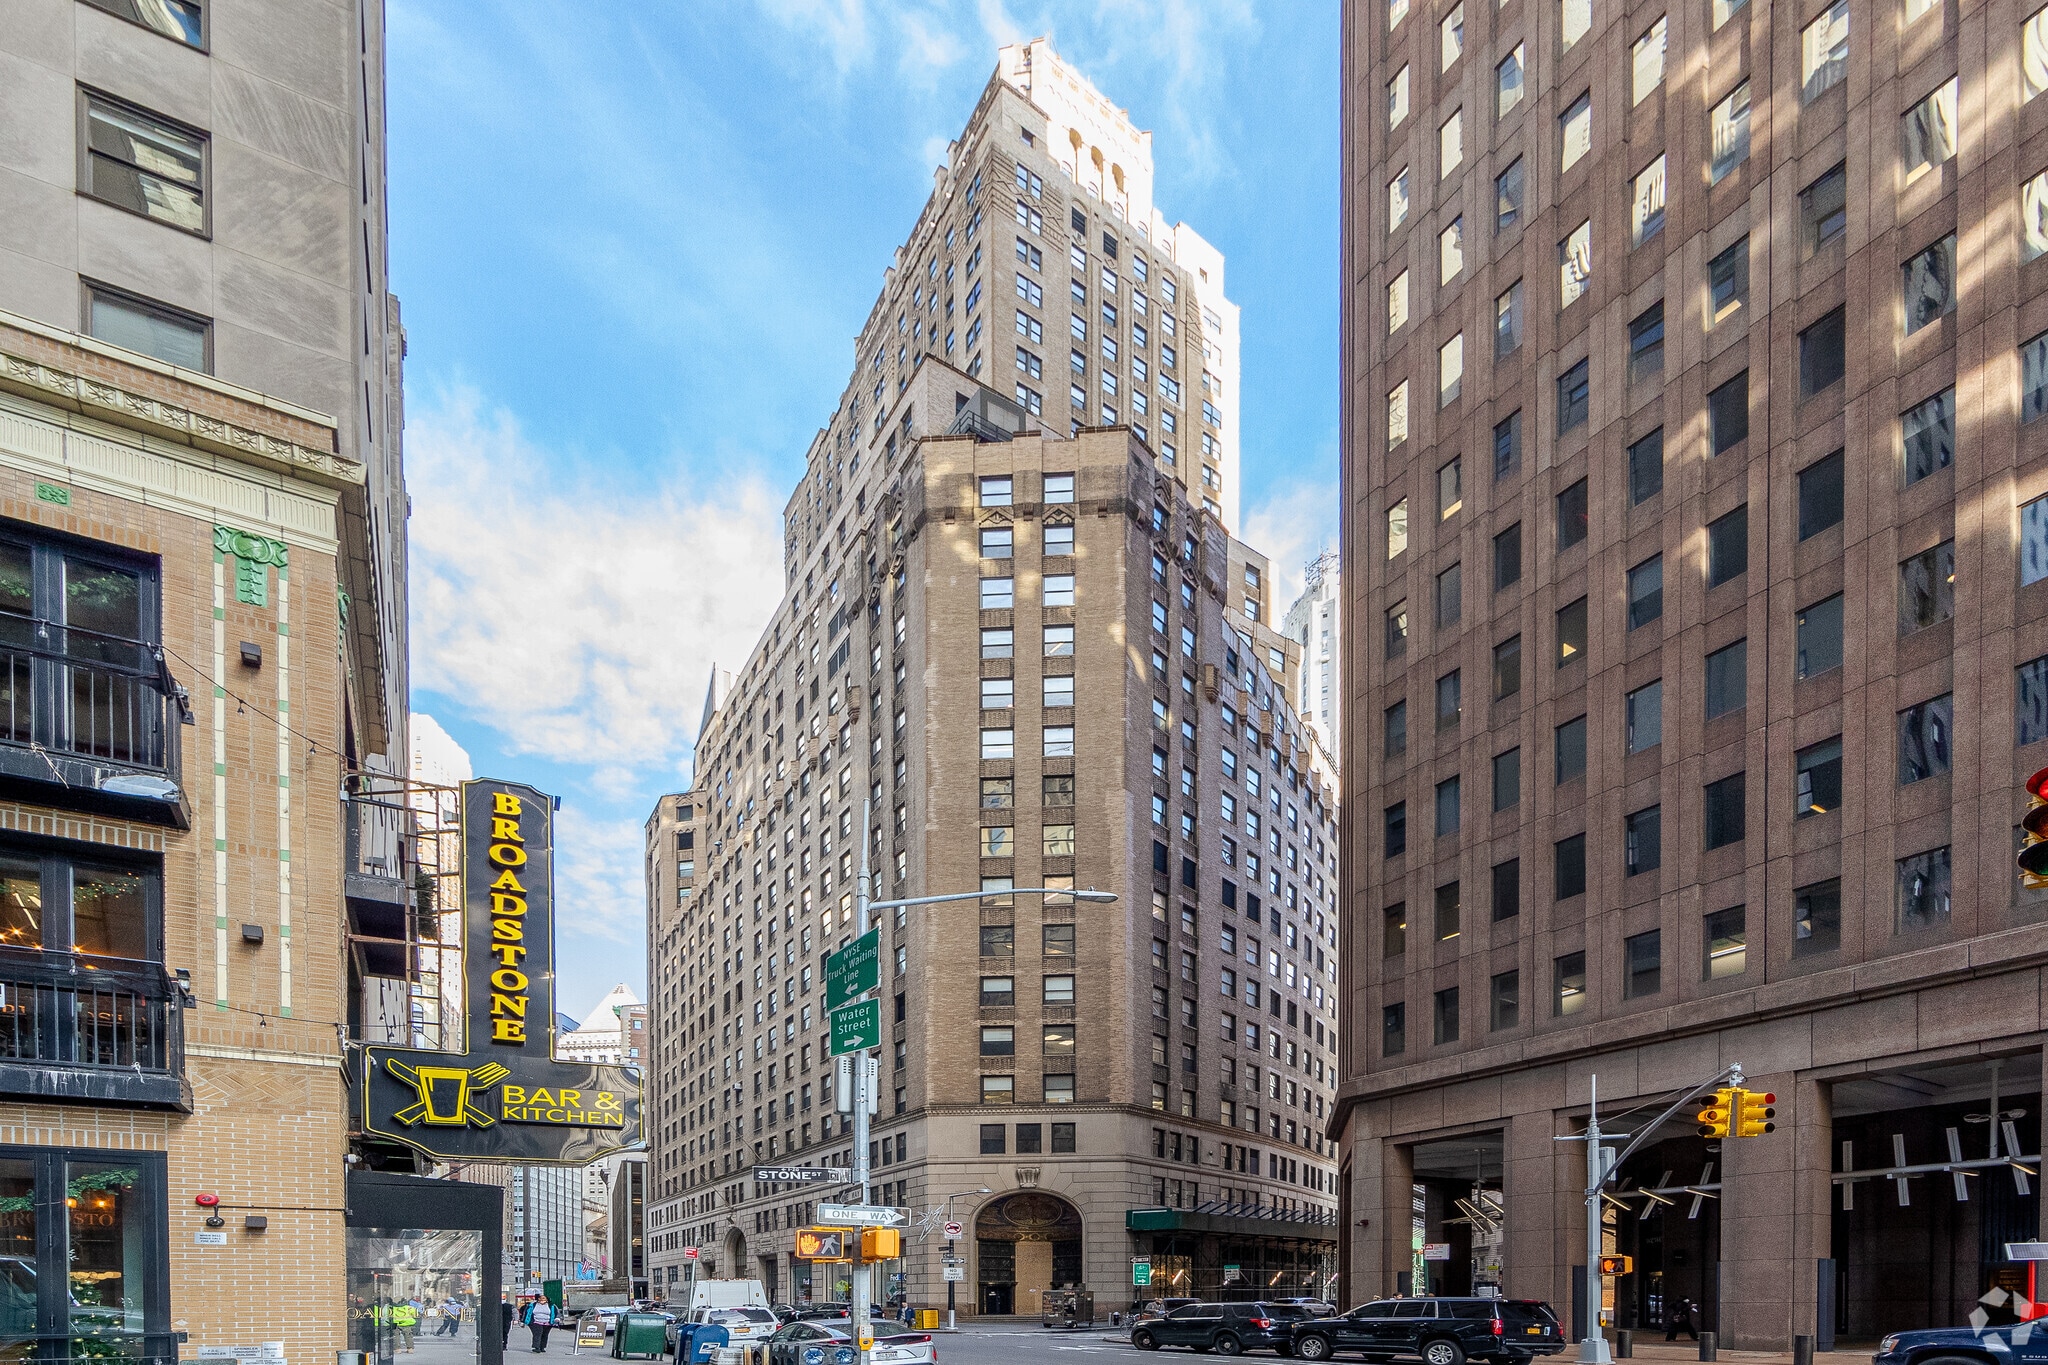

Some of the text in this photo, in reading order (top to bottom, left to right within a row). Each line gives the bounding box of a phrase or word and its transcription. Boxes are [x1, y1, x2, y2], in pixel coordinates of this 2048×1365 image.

[489, 792, 529, 1042] BROADSTONE
[843, 942, 861, 960] NYSE
[828, 946, 877, 981] Truck Waiting
[844, 969, 860, 984] Line
[838, 1006, 870, 1022] Water
[838, 1017, 871, 1034] Street
[503, 1085, 622, 1111] BAR &
[503, 1105, 623, 1126] KITCHEN
[758, 1171, 811, 1180] STONE
[832, 1210, 896, 1221] ONE WAY
